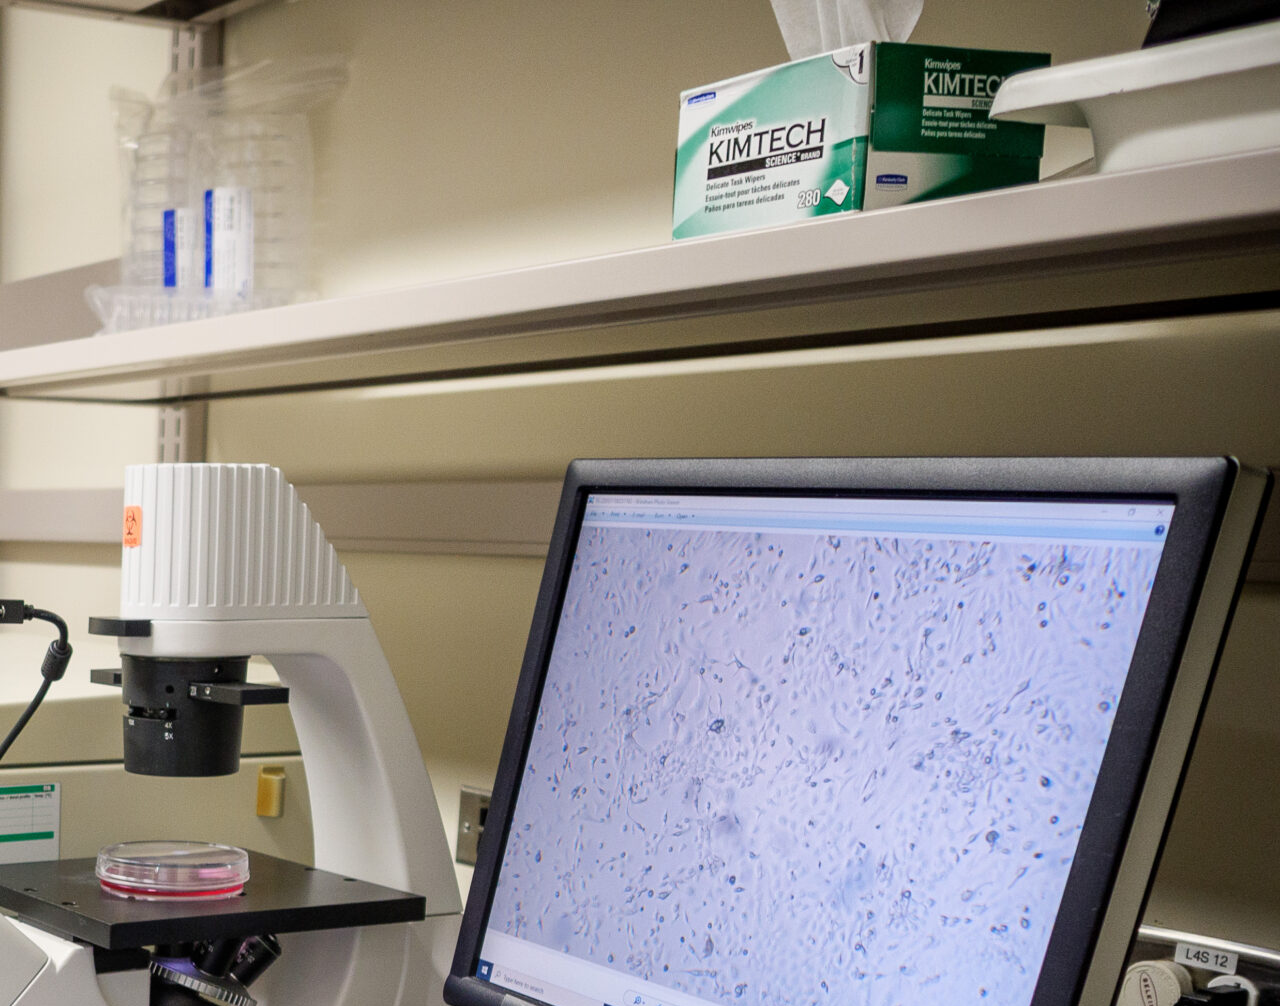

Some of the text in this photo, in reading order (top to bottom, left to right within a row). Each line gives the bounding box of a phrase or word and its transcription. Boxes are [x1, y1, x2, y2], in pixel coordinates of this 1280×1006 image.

[924, 58, 961, 71] Kimwipes
[924, 72, 1006, 97] KIMTEC
[922, 109, 972, 119] Delicate Task Wipers
[710, 120, 754, 138] Kimwipes
[708, 118, 826, 166] KIMTECH
[800, 150, 821, 161] BRAND
[705, 189, 736, 203] Essuie-tout
[736, 187, 750, 199] pour
[772, 178, 801, 190] délicates
[706, 174, 766, 192] Delicate Task Wipers
[704, 193, 785, 214] Paños para tareas delicadas
[797, 189, 820, 210] 280
[1186, 948, 1228, 968] L4S 12
